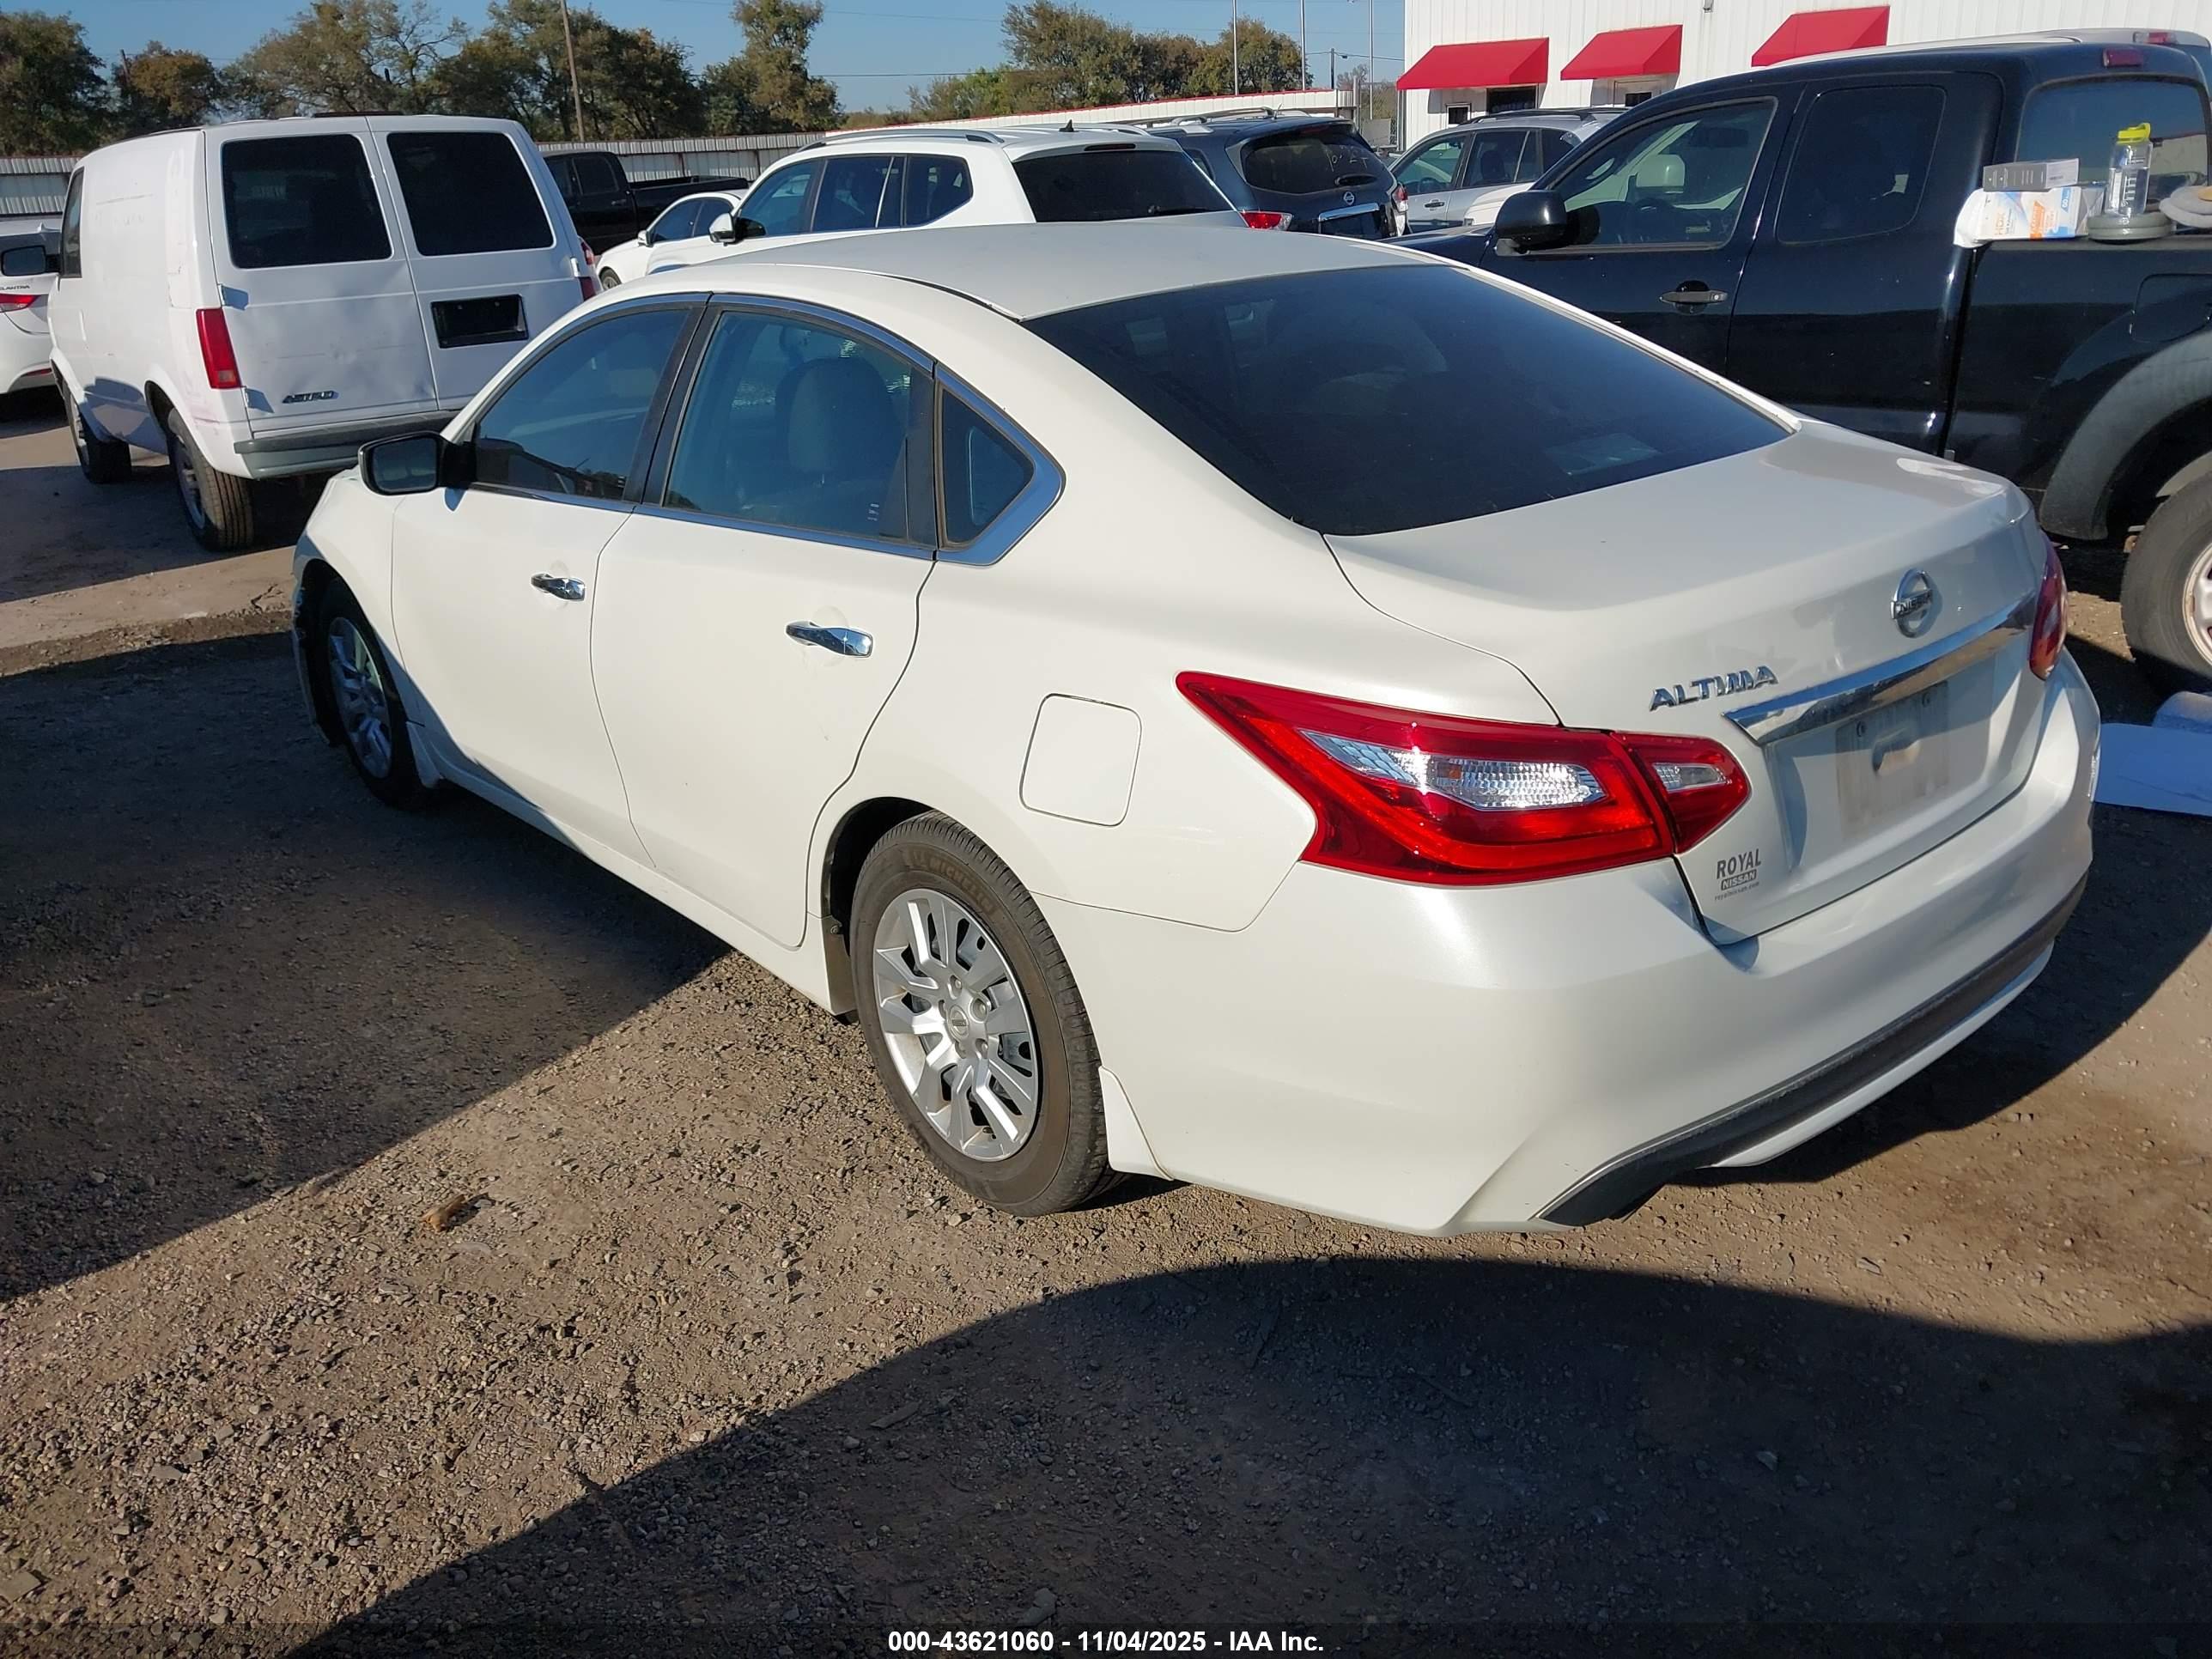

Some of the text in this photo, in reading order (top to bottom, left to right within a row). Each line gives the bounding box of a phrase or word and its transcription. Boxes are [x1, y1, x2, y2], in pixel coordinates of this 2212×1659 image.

[1649, 665, 1779, 712] ALTIMA
[1717, 848, 1762, 879] ROYAL
[1722, 869, 1757, 890] NISSAN
